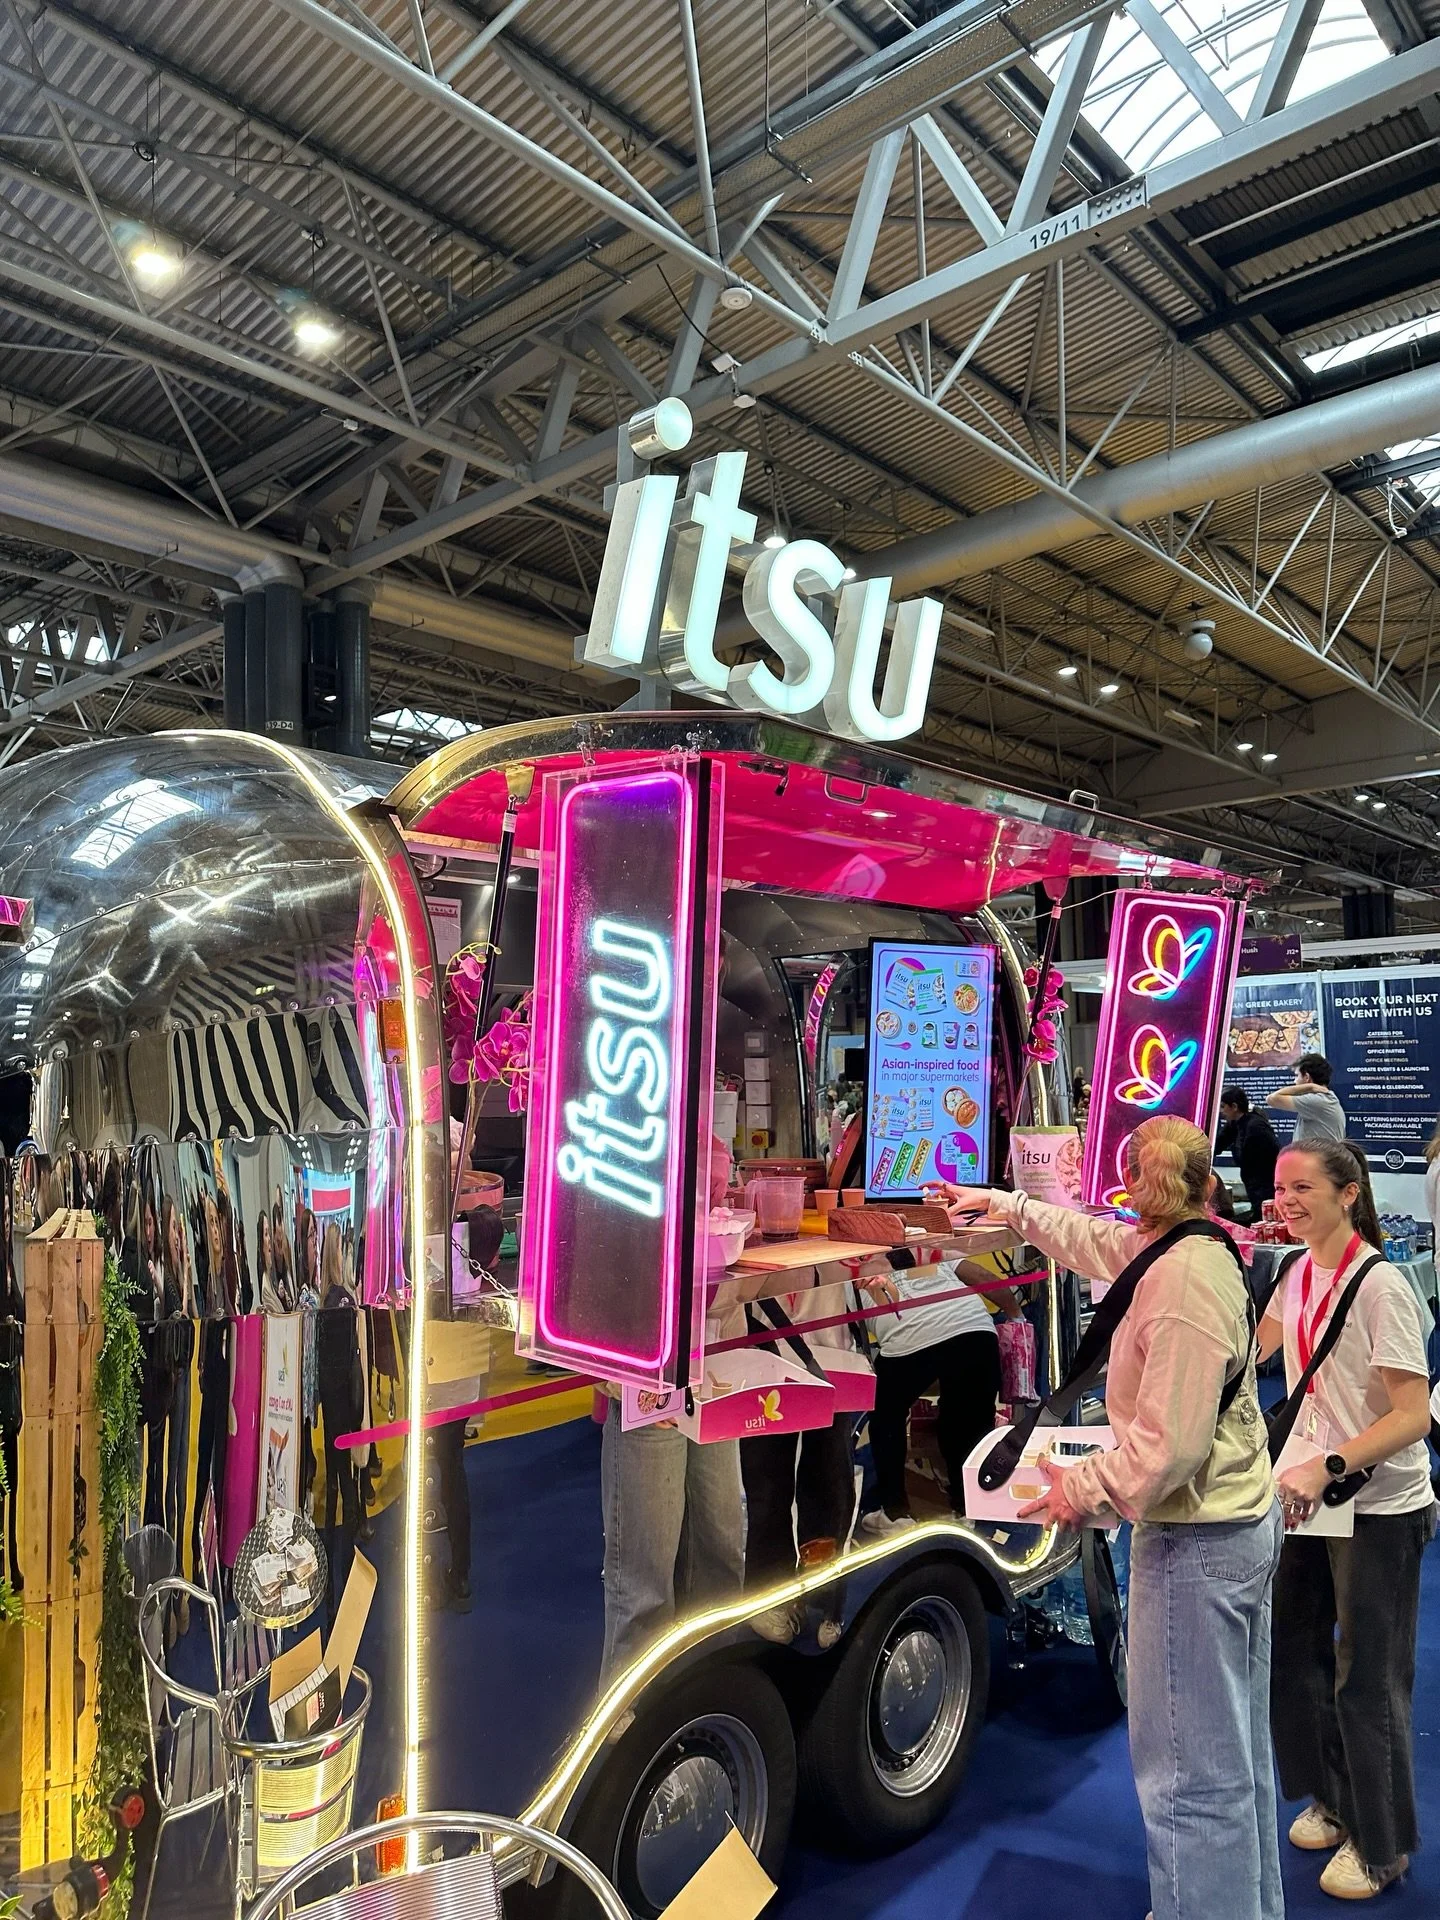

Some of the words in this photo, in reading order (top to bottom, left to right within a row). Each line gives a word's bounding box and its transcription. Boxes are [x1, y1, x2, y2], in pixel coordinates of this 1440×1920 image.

[1029, 214, 1080, 250] 19/11
[597, 397, 944, 742] itsu
[1241, 946, 1258, 955] Hush
[895, 972, 909, 983] itsu
[917, 983, 931, 991] itsu
[1245, 1000, 1272, 1009] GREEK
[1273, 998, 1304, 1007] BAKERY
[1334, 996, 1369, 1007] BOOK
[1370, 995, 1403, 1005] YOUR
[1406, 993, 1439, 1004] NEXT
[1342, 1008, 1380, 1019] EVENT
[1382, 1007, 1412, 1018] WITH
[1415, 1006, 1433, 1016] US
[557, 918, 671, 1218] itsu
[881, 1058, 955, 1072] Asian-inspired
[956, 1059, 980, 1071] food
[881, 1071, 890, 1081] in
[892, 1072, 918, 1083] major
[920, 1072, 980, 1083] supermarkets
[891, 1107, 905, 1116] itsu
[1021, 1149, 1051, 1165] itsu
